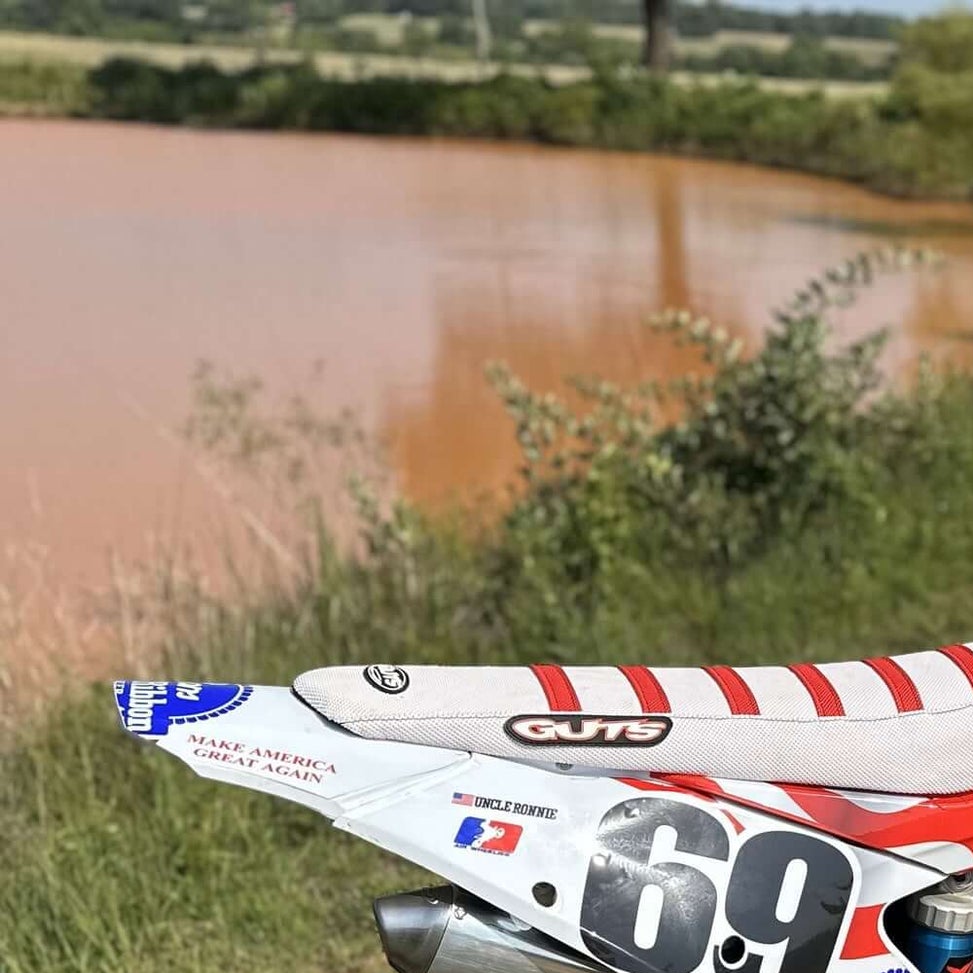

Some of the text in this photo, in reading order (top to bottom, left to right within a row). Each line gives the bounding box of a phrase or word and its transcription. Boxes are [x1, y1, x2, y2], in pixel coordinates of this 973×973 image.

[511, 717, 667, 742] GUTS
[187, 734, 337, 775] MAKE AMERICA
[193, 747, 323, 784] GREAT AGAIN
[474, 796, 558, 820] UNCLE RONNIE
